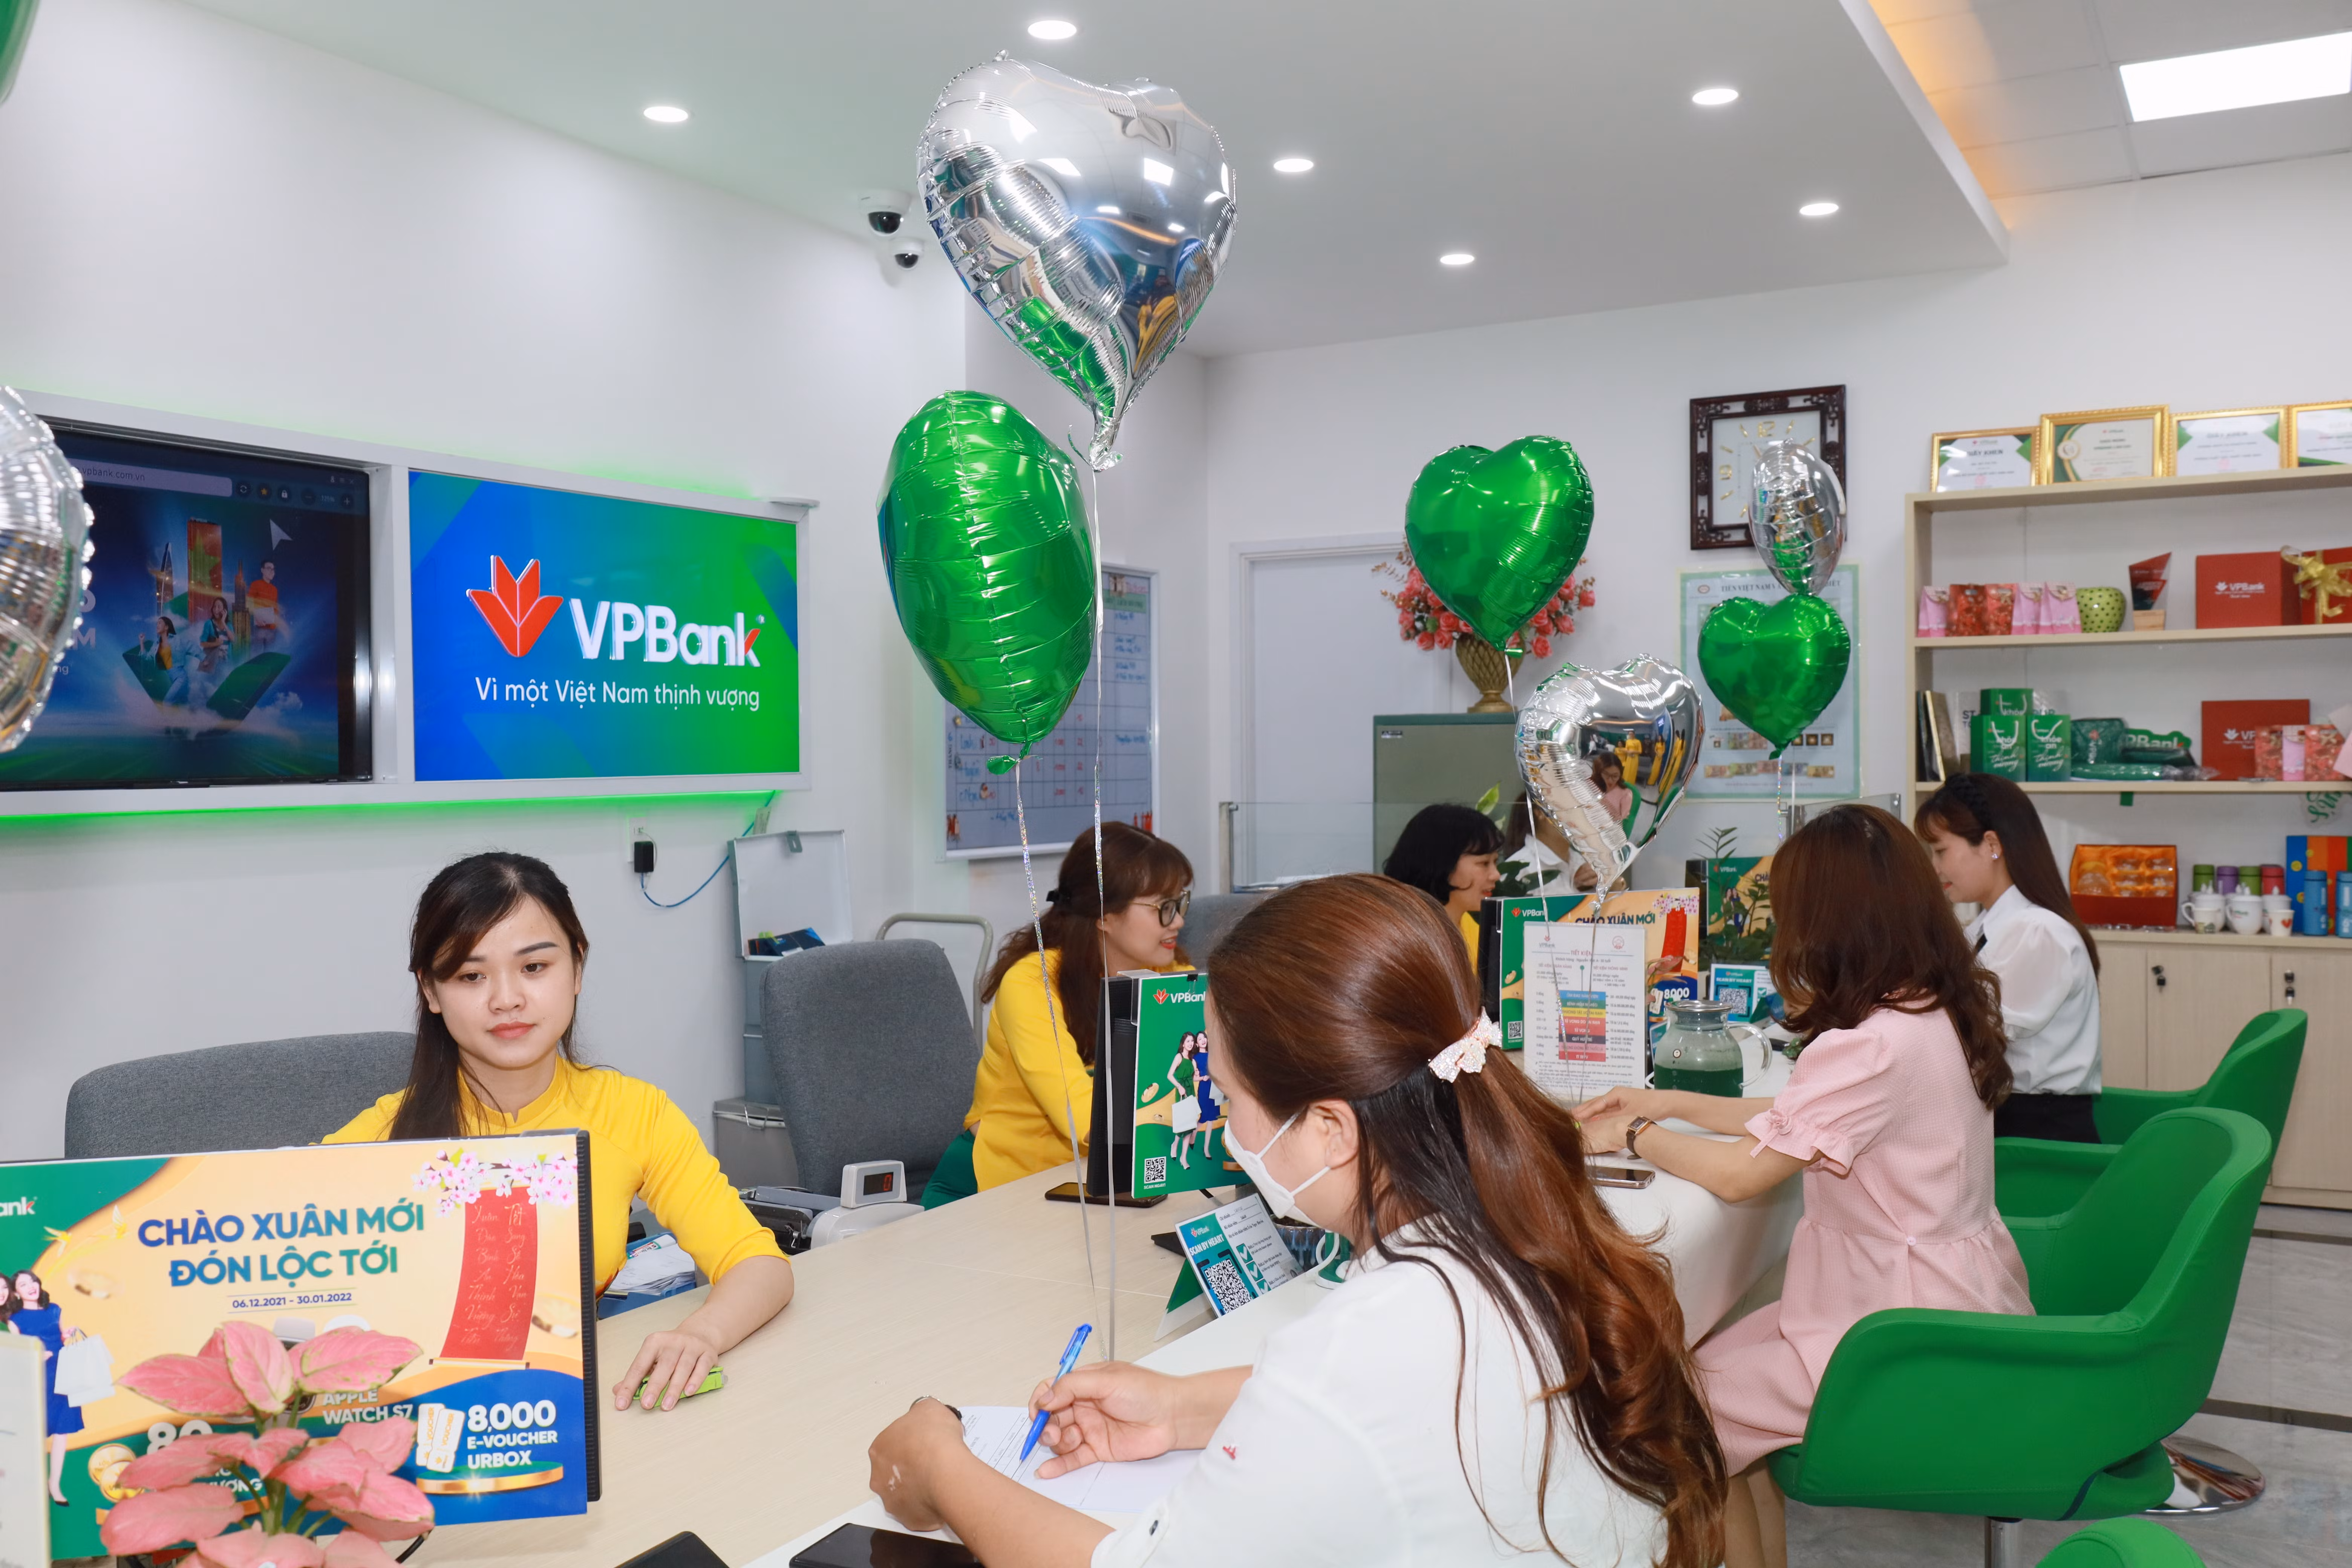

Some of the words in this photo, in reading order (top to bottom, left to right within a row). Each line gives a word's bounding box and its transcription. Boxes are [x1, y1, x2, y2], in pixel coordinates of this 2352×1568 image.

[568, 598, 761, 667] VPBank
[475, 677, 497, 701] Vì
[505, 679, 548, 708] một
[554, 679, 596, 709] Việt
[603, 681, 648, 703] Nam
[654, 683, 701, 710] thịnh
[706, 688, 760, 711] vượng
[1522, 909, 1547, 917] VPBan
[1607, 913, 1634, 924] XUÂN
[1635, 911, 1655, 924] MỚI
[0, 1196, 35, 1217] ank
[138, 1210, 245, 1247] CHÀO
[251, 1203, 348, 1241] XUÂN
[356, 1197, 424, 1234] MỚI
[1189, 1243, 1204, 1256] SCAN
[1201, 1240, 1209, 1251] BY
[1207, 1234, 1225, 1248] HEART
[169, 1250, 251, 1286] ĐÓN
[260, 1245, 333, 1288] LỘC
[339, 1239, 398, 1276] TỚI
[232, 1297, 286, 1309] 06.12.2021
[297, 1293, 352, 1305] 30.01.2022
[323, 1389, 378, 1406] APPLE
[322, 1406, 388, 1424] WATCH
[392, 1404, 413, 1419] S7
[467, 1400, 556, 1433] 8,000
[442, 1413, 455, 1446] VOUCHER
[467, 1430, 558, 1449] E-VOUCHER
[467, 1450, 533, 1470] URBOX
